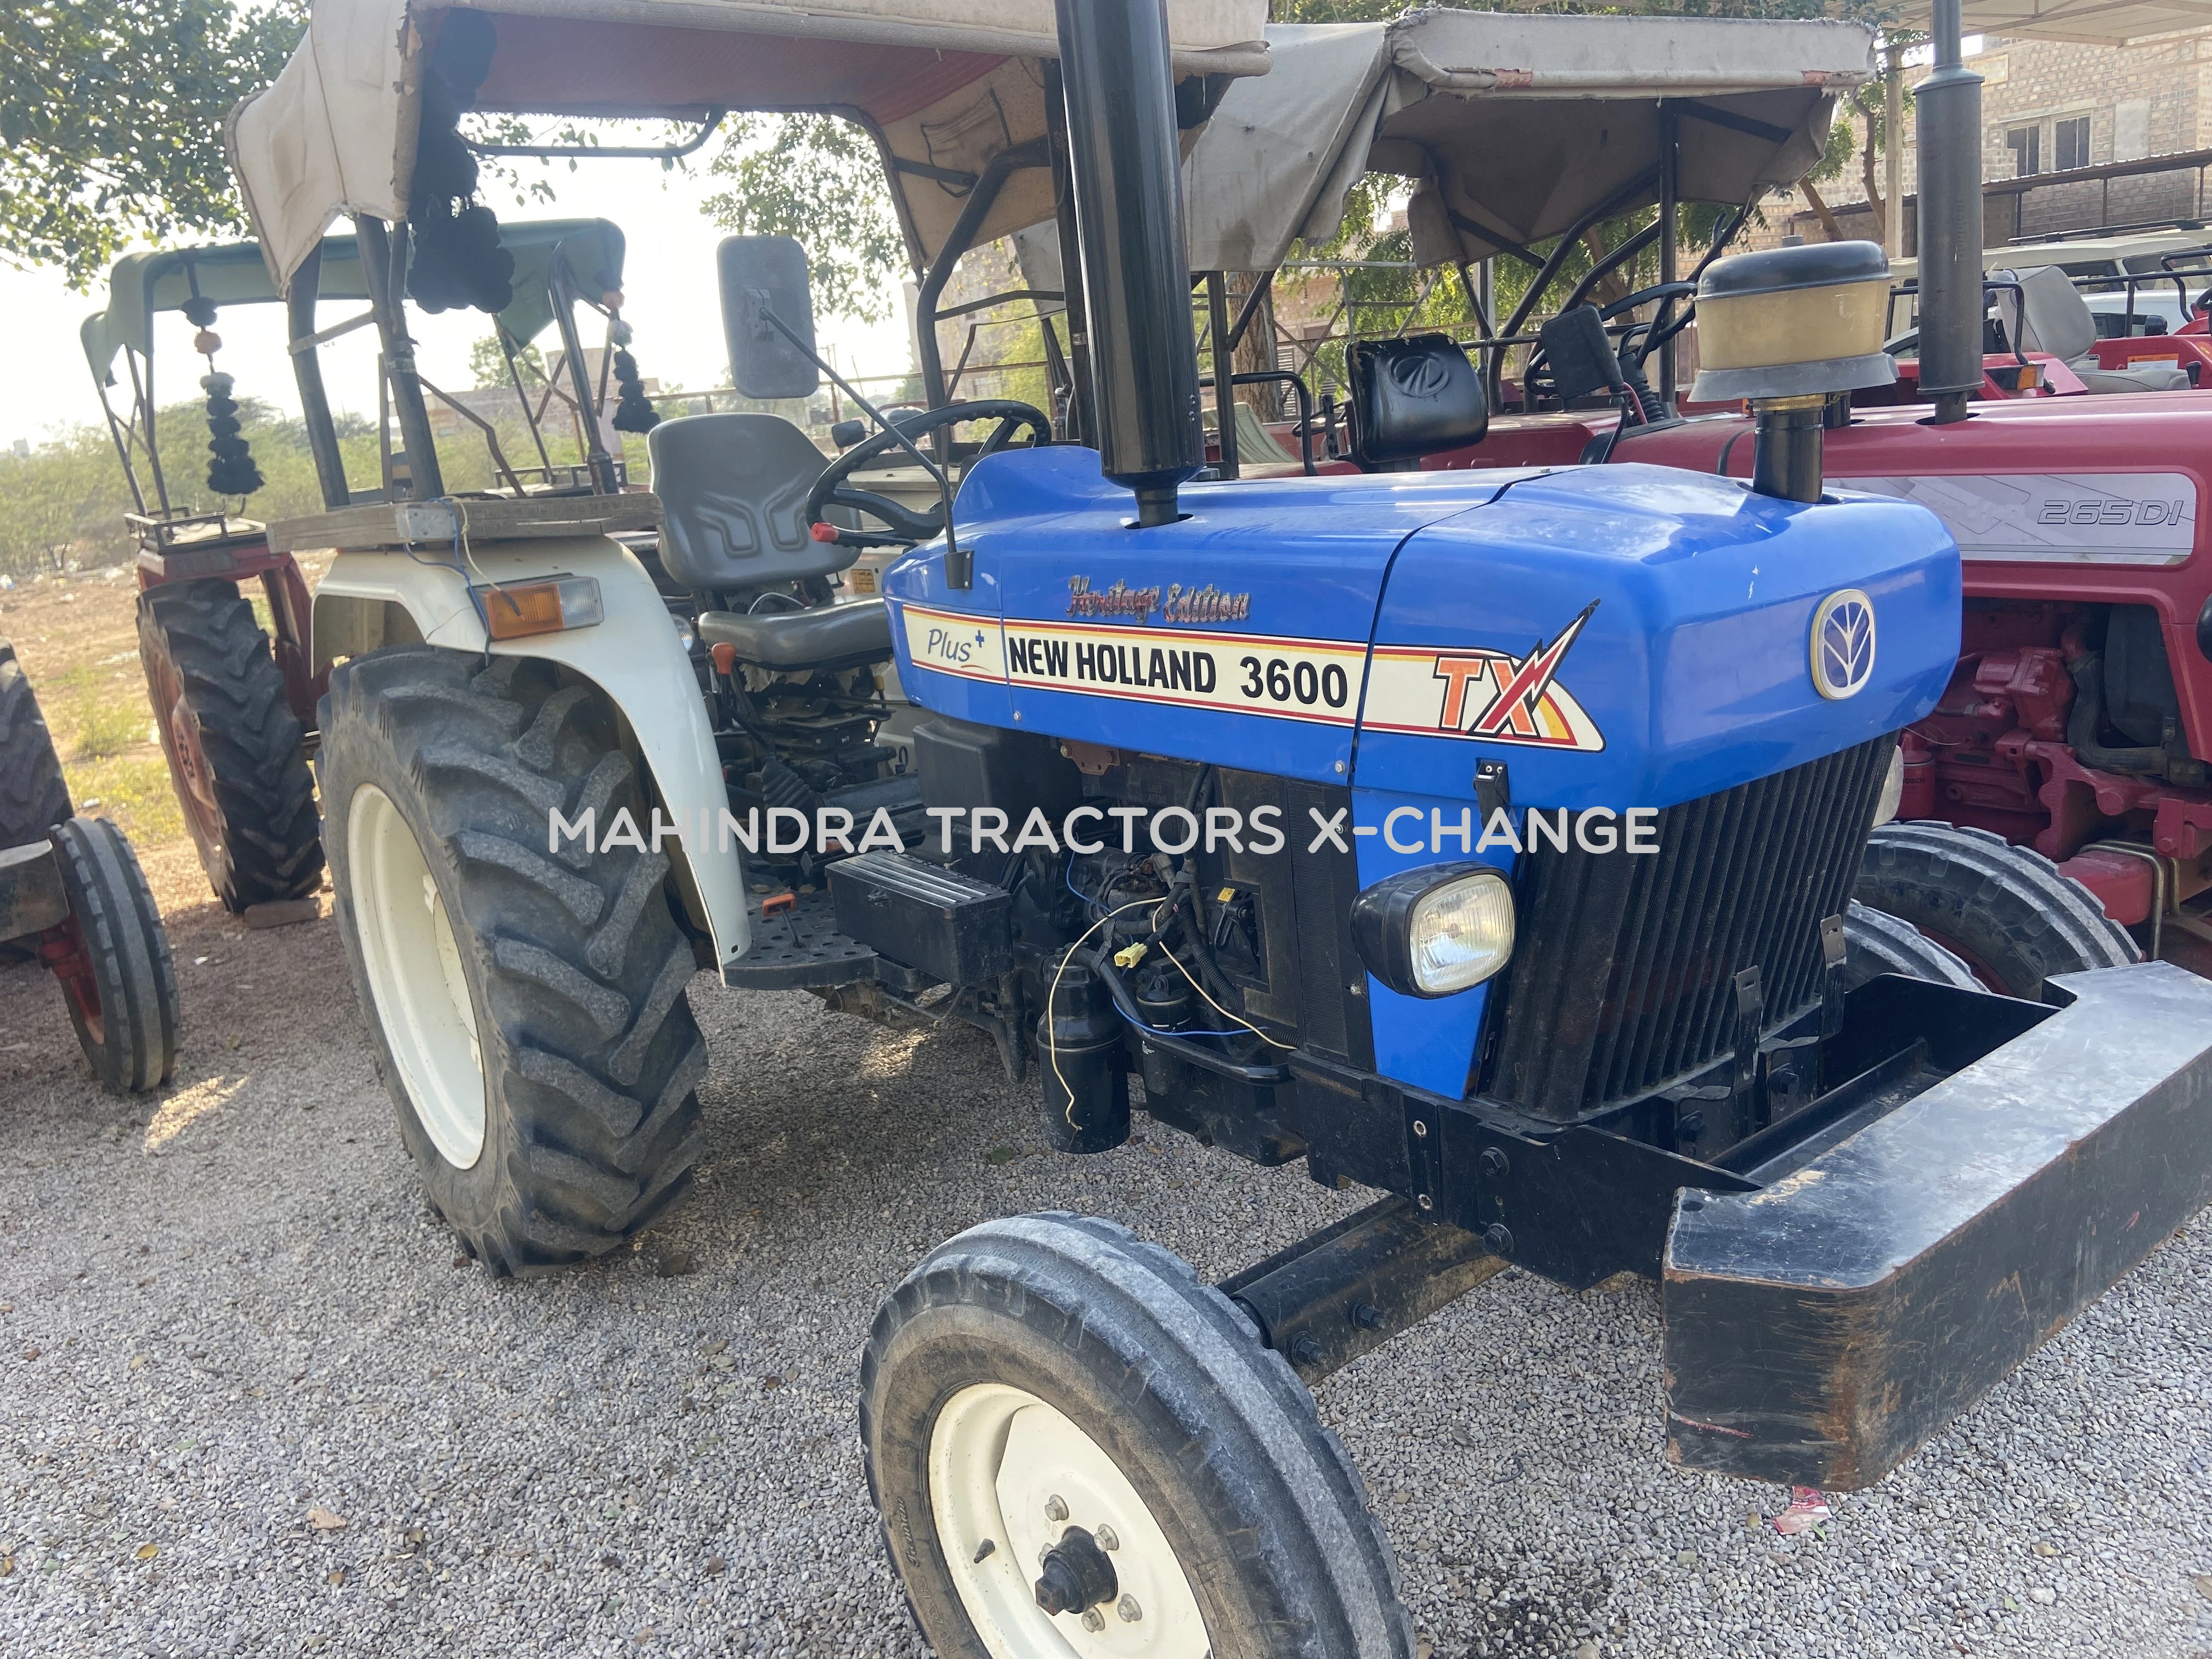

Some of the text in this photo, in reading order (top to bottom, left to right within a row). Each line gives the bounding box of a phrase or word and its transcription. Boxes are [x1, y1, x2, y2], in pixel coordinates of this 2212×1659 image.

[1066, 574, 1251, 624] Heritage Edition
[1009, 637, 1347, 708] NEW HOLLAND 3600
[1433, 613, 1585, 740] TX
